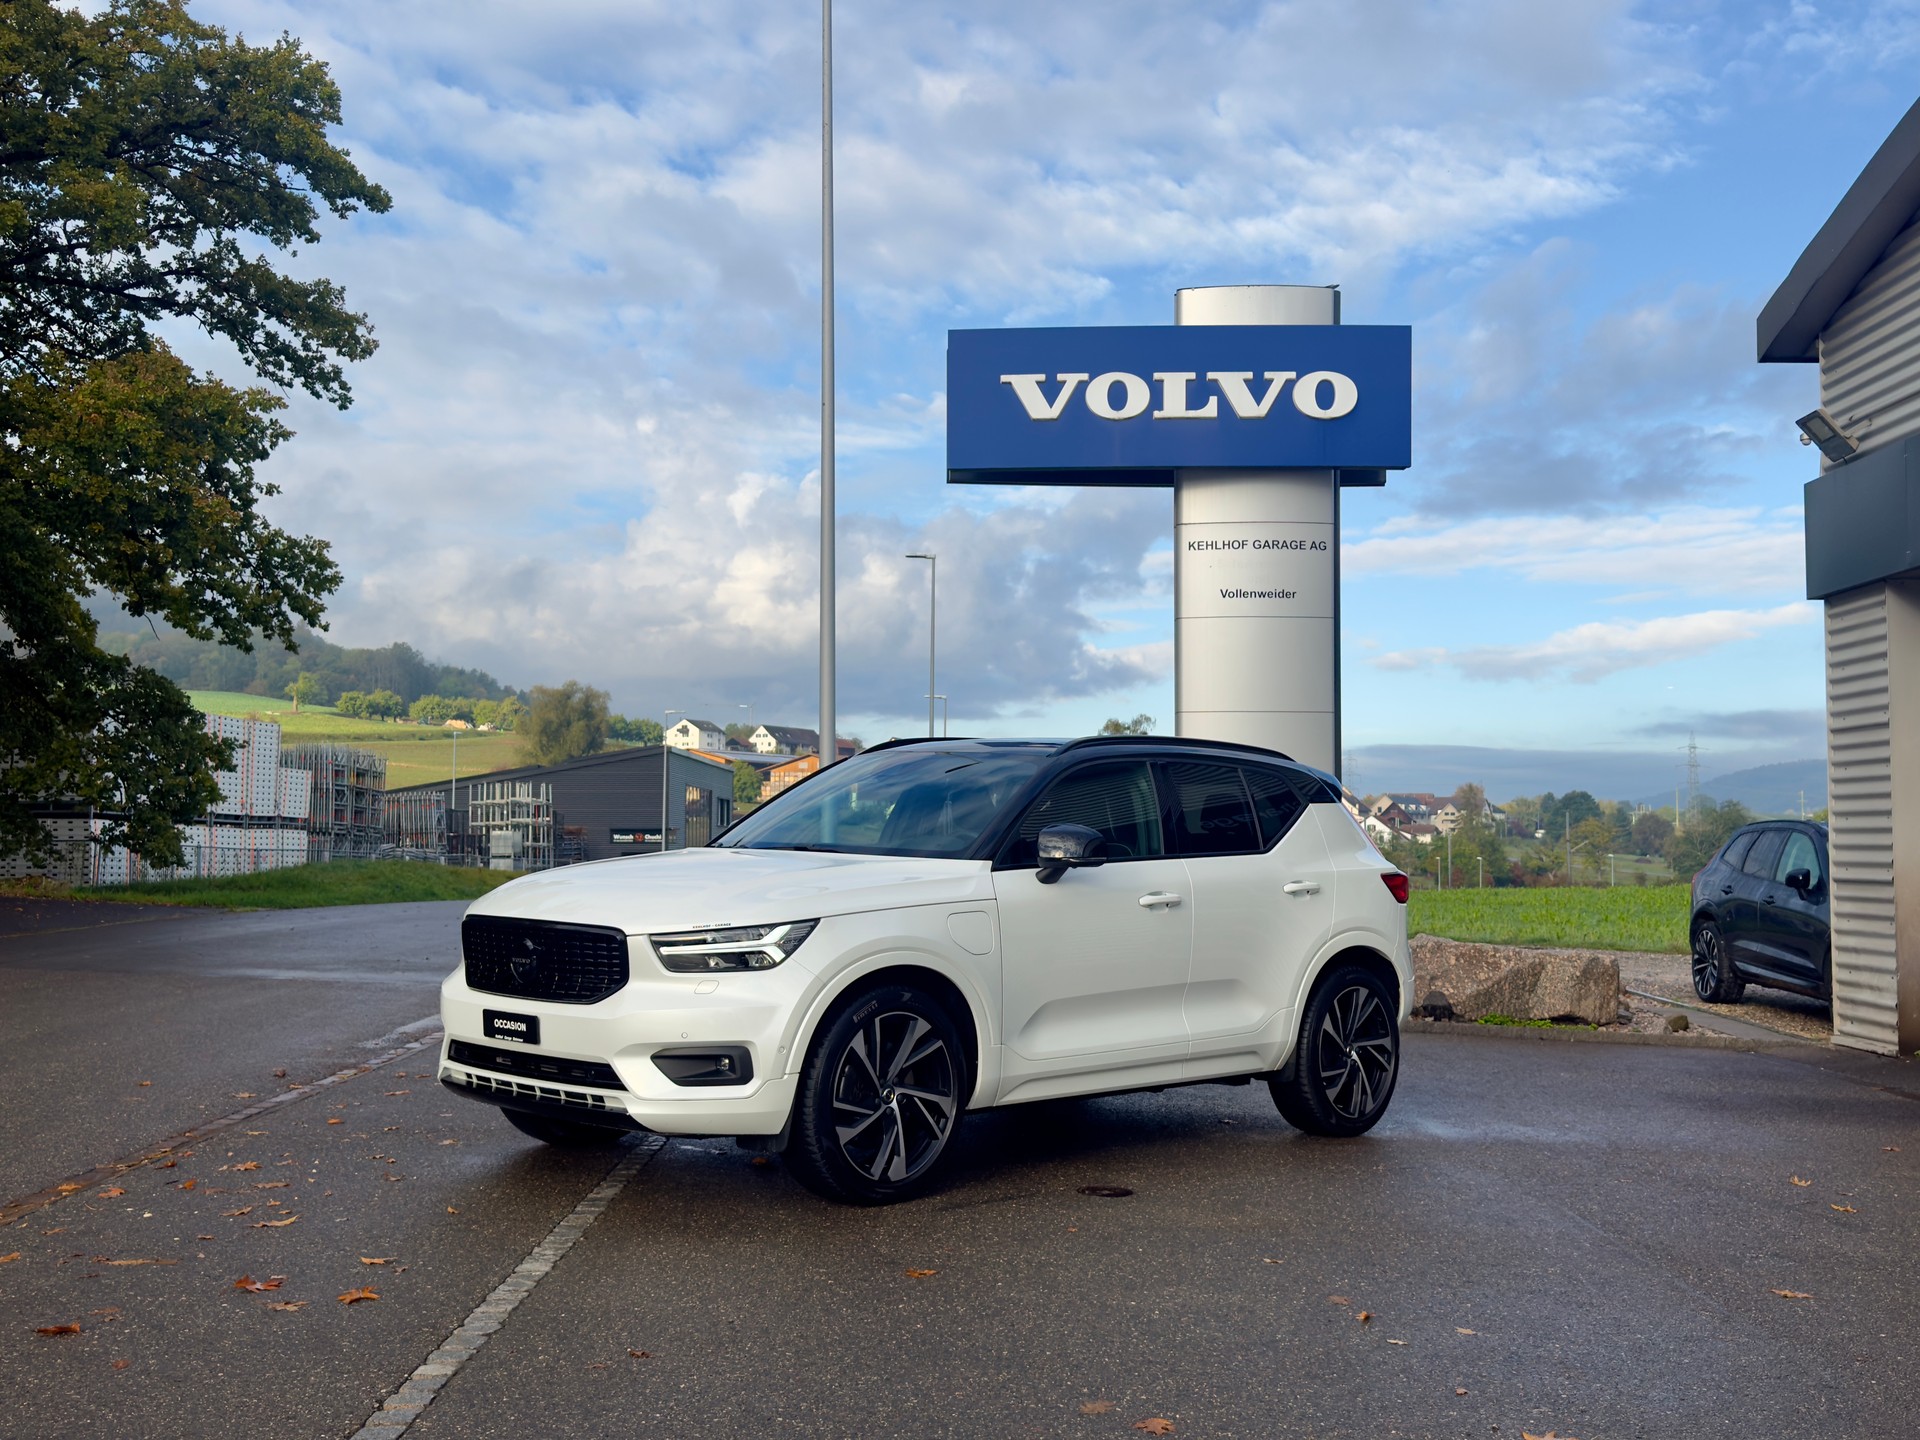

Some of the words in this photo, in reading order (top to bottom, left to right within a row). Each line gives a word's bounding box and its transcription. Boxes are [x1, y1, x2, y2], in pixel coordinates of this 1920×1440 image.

[1000, 371, 1358, 420] VOLVO
[1188, 540, 1249, 551] KEHLHOF
[1252, 540, 1306, 550] GARAGE
[1309, 540, 1328, 551] AG
[1220, 589, 1297, 599] Vollenweider
[494, 1018, 527, 1032] OCCASION
